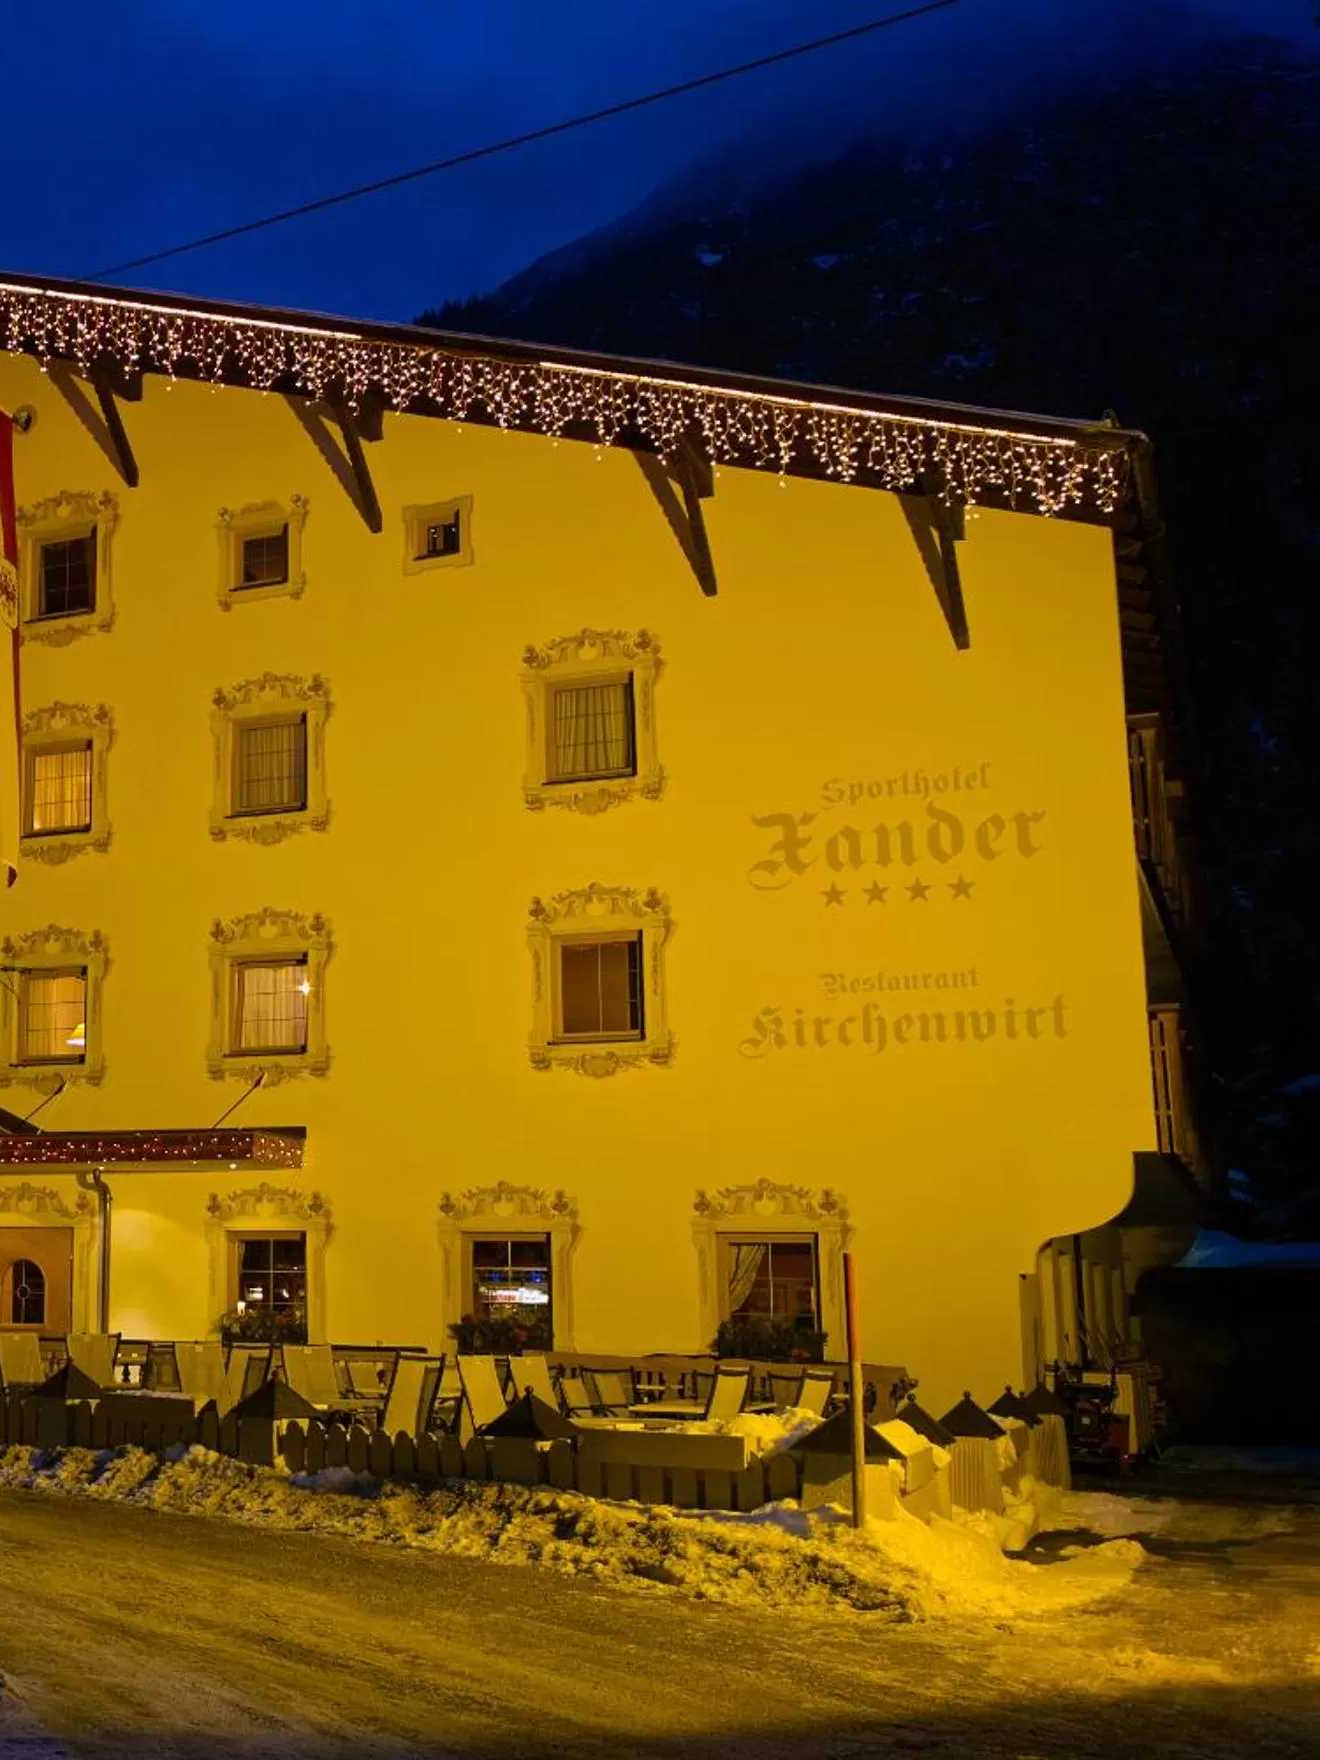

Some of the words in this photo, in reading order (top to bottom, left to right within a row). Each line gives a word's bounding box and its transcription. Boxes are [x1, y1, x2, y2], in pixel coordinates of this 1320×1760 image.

[820, 762, 991, 809] Sporthotel
[747, 800, 1046, 891] Xander
[818, 966, 980, 999] Restaurant
[738, 995, 1073, 1059] Kirchenwirt
